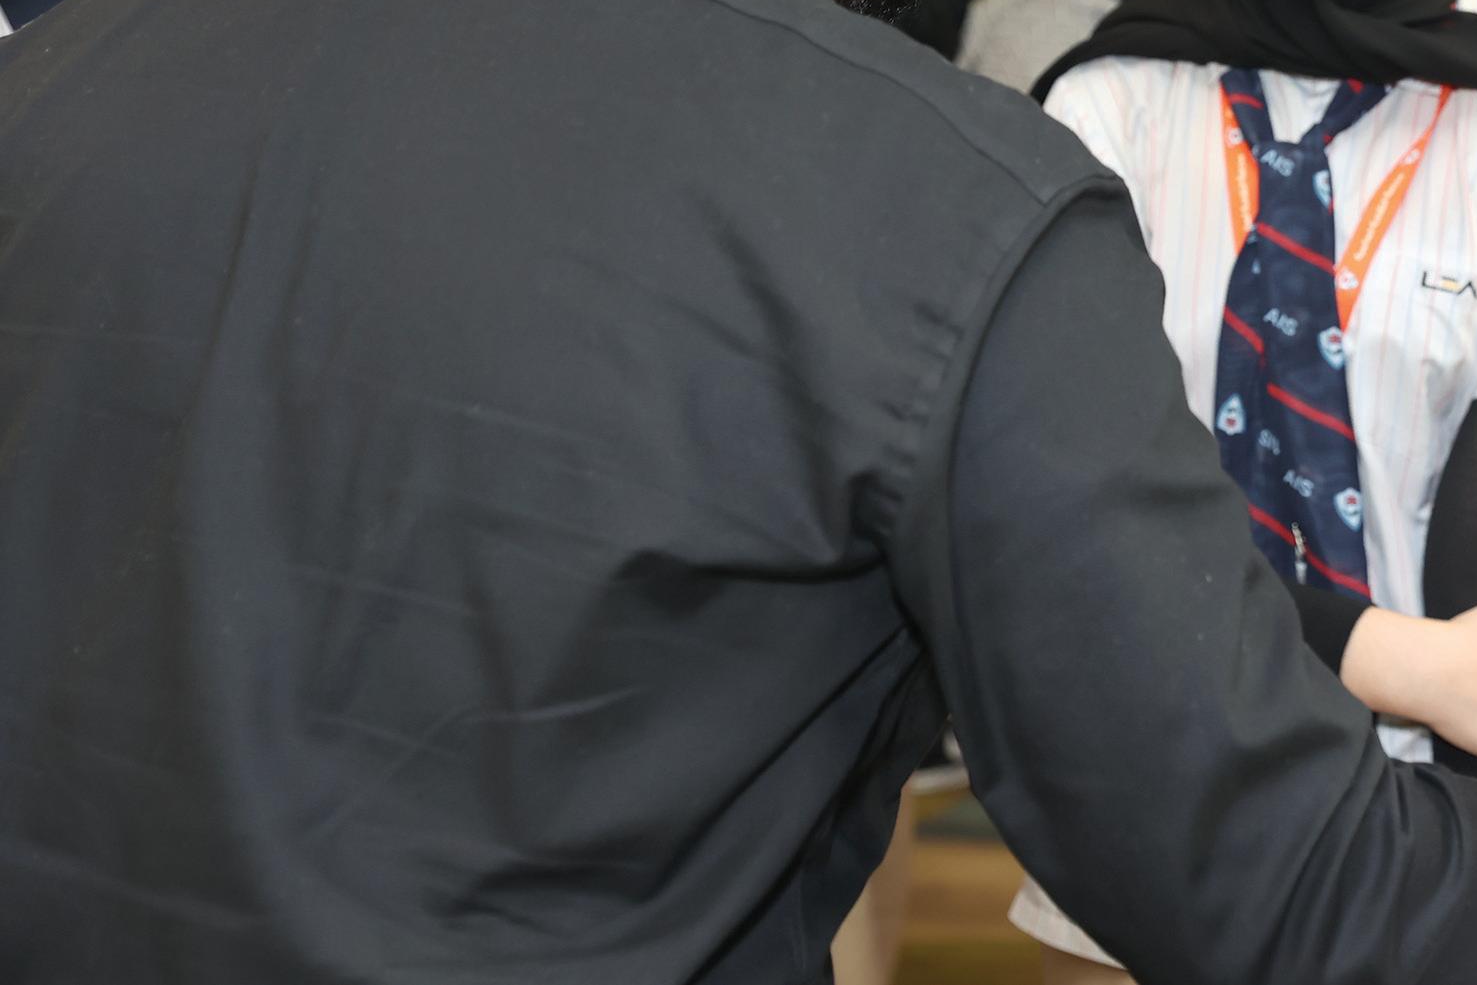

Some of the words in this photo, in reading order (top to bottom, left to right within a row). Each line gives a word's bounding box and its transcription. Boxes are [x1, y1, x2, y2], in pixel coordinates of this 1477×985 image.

[1260, 149, 1296, 177] AIS
[1263, 308, 1298, 336] AIS
[1283, 469, 1315, 497] AIS
